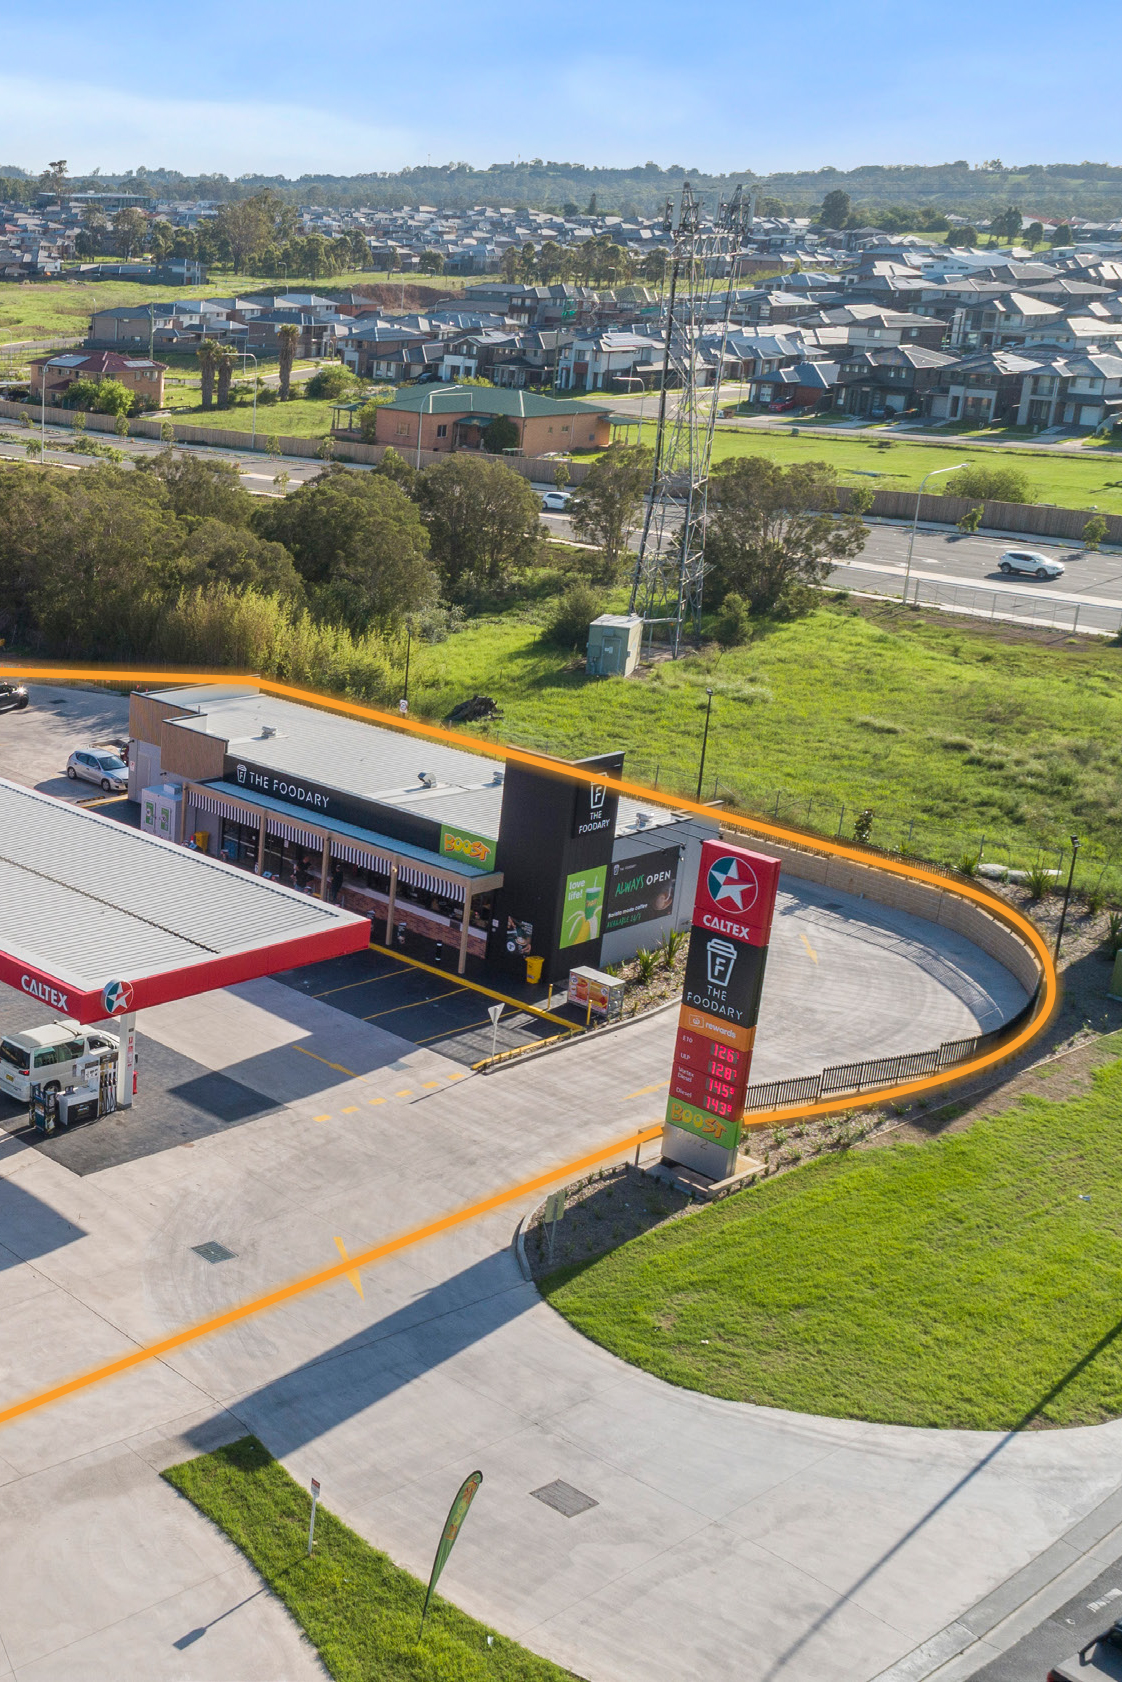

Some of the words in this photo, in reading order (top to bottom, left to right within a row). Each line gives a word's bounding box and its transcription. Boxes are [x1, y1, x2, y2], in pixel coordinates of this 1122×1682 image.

[249, 772, 269, 789] THE
[273, 780, 330, 808] FOODARY
[590, 810, 603, 820] THE
[578, 819, 611, 834] FOODARY
[444, 833, 491, 862] BOOST
[569, 880, 586, 890] love
[615, 874, 645, 897] ALWAYS
[646, 870, 671, 885] OPEN
[568, 889, 583, 901] life!
[606, 915, 630, 928] AVAILABLE
[703, 914, 750, 940] CALTEX
[714, 957, 726, 976] F
[21, 974, 68, 1011] CALTEX
[707, 985, 727, 1001] THE
[687, 991, 743, 1020] FOODARY
[705, 1022, 737, 1039] rewards
[682, 1034, 693, 1043] E10
[680, 1052, 690, 1060] ULP
[677, 1072, 693, 1082] Diesel
[678, 1066, 694, 1077] Vortex
[675, 1087, 693, 1098] Diesel
[671, 1103, 727, 1138] BOOST
